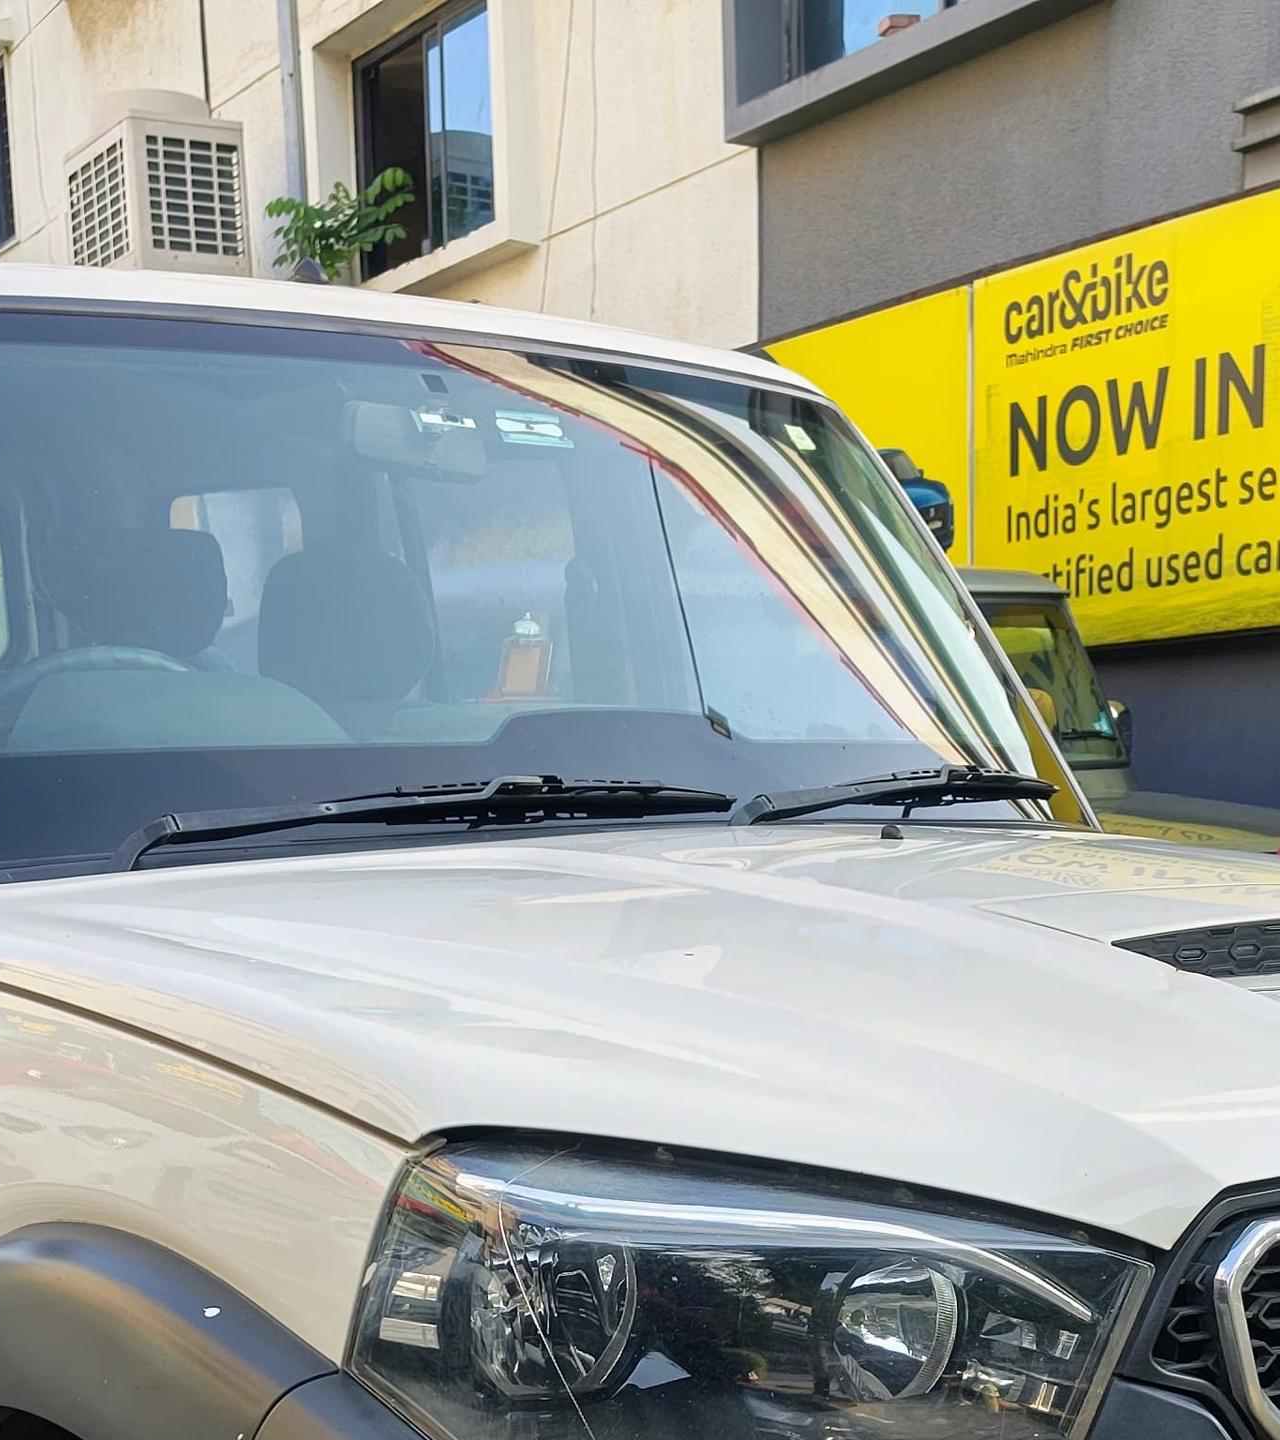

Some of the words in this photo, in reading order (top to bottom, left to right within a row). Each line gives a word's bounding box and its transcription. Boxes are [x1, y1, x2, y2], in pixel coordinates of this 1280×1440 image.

[1005, 253, 1169, 344] car&bike
[1006, 344, 1067, 368] Mahindra
[1070, 329, 1112, 351] FIRST
[1115, 314, 1169, 340] CHOICE
[1008, 366, 1170, 477] NOW
[1193, 344, 1266, 441] IN
[1006, 487, 1101, 543] India's
[1111, 469, 1229, 529] largest
[1042, 547, 1134, 599] tified
[1146, 533, 1224, 588] used
